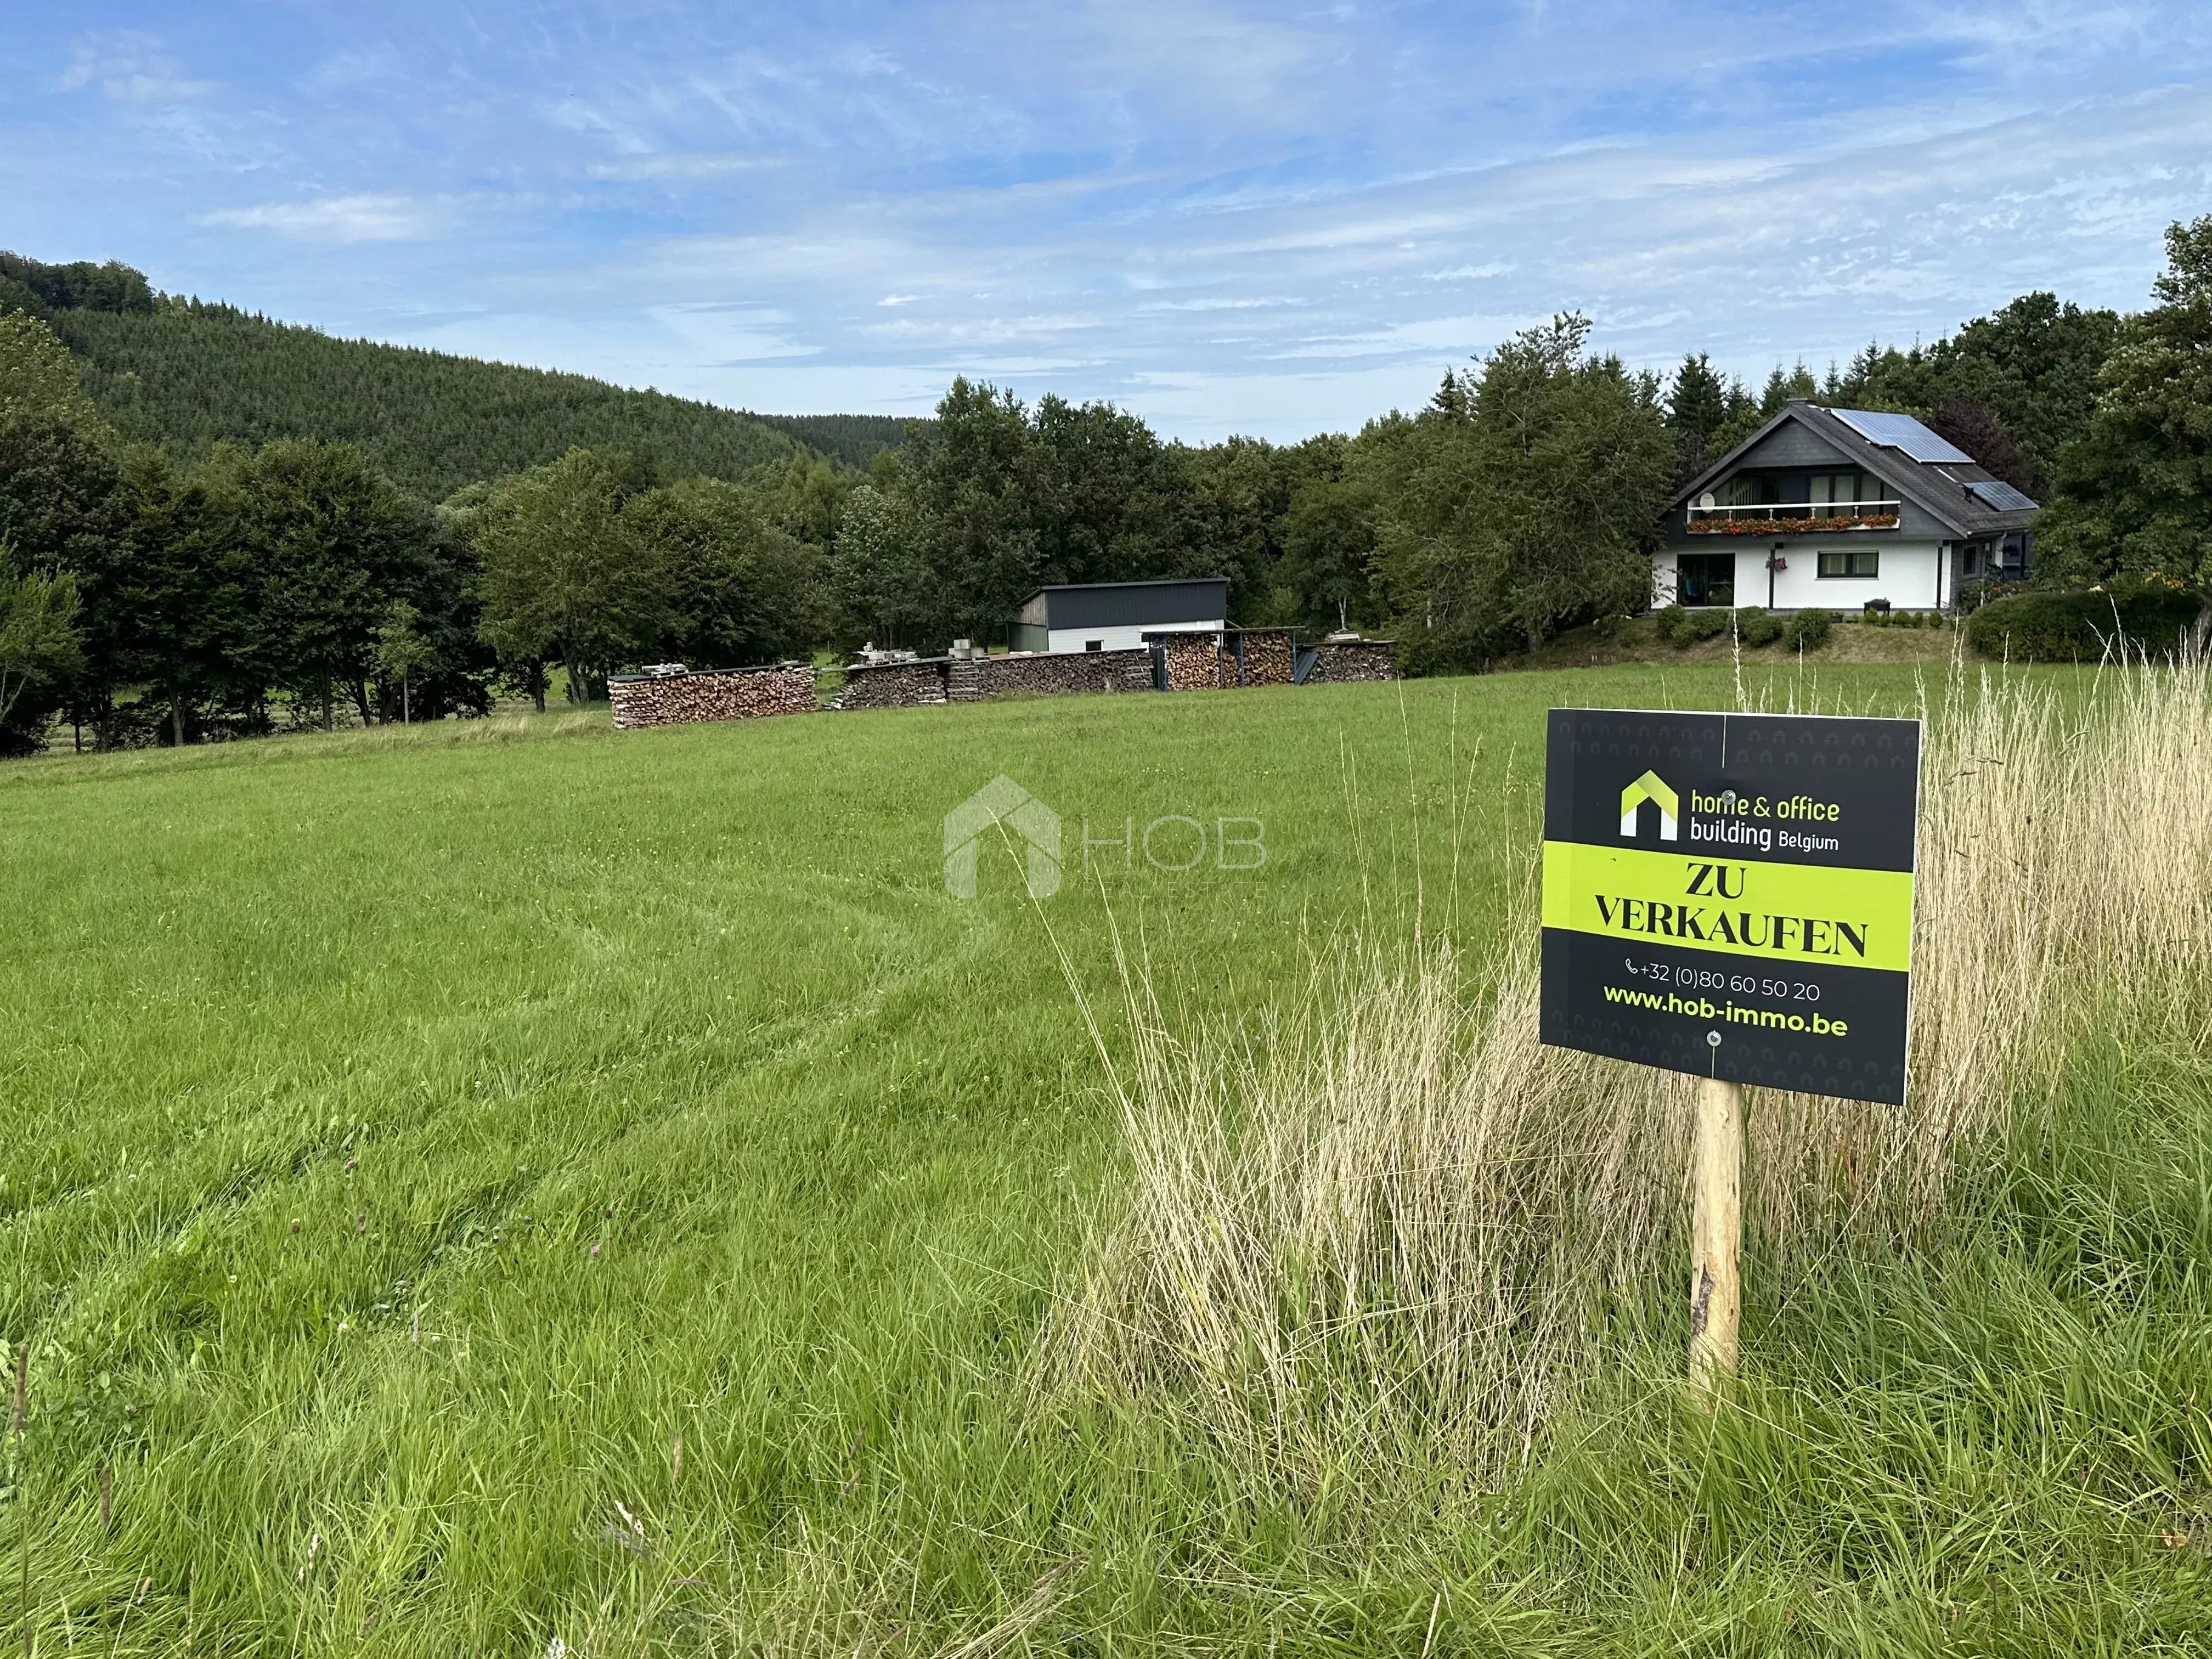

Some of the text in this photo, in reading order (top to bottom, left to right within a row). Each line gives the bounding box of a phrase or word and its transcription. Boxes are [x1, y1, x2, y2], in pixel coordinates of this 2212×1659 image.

[1691, 789, 1841, 822] home & office
[1690, 816, 1839, 853] building Belgium
[1685, 862, 1747, 900] ZU
[1594, 894, 1869, 958] VERKAUFEN
[1640, 963, 1820, 1001] +32 (0)80 60 50 20
[1603, 986, 1848, 1036] www.hob-immo.be
